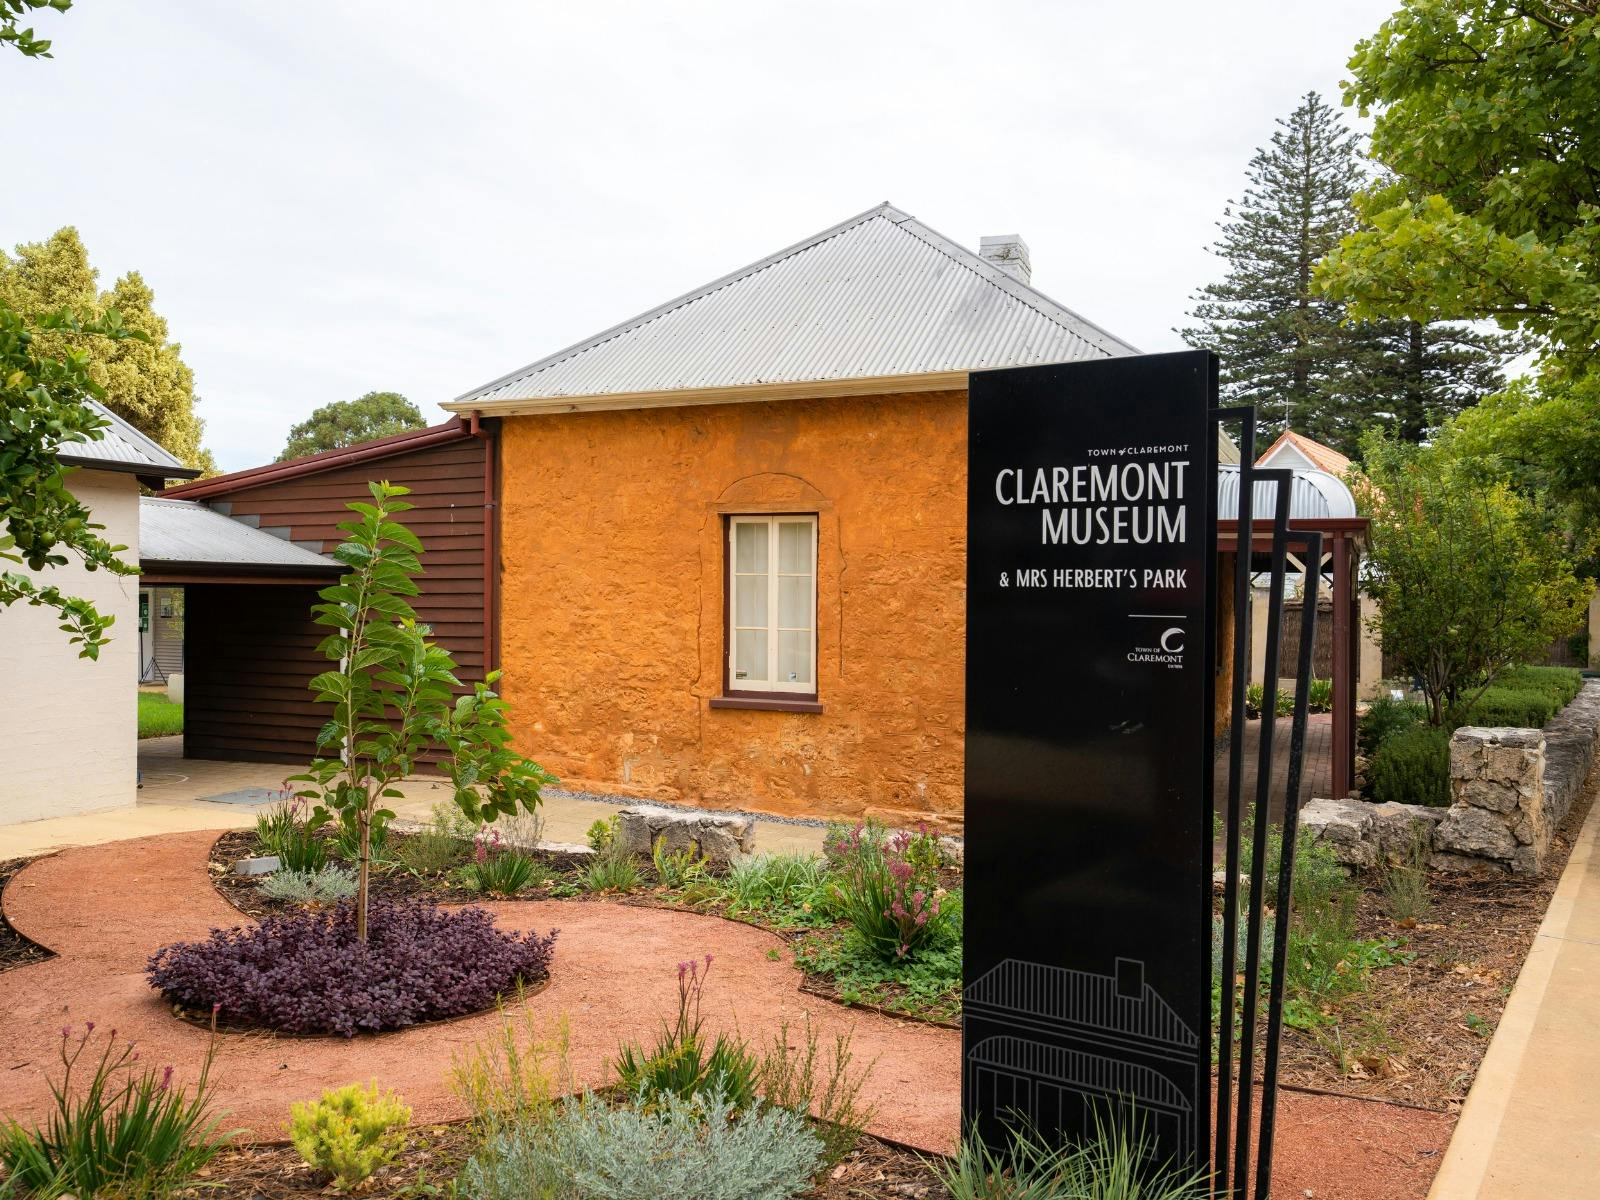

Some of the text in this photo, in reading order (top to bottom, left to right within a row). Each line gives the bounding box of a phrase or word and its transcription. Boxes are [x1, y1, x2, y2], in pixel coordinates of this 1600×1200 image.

[1087, 448, 1116, 457] TOWN
[1127, 444, 1189, 455] CLAREMONT
[995, 461, 1190, 505] CLAREMONT
[1042, 505, 1186, 545] MUSEUM
[999, 569, 1187, 589] & MRS HERBERT'S PARK
[1127, 652, 1184, 663] CLAREMONT
